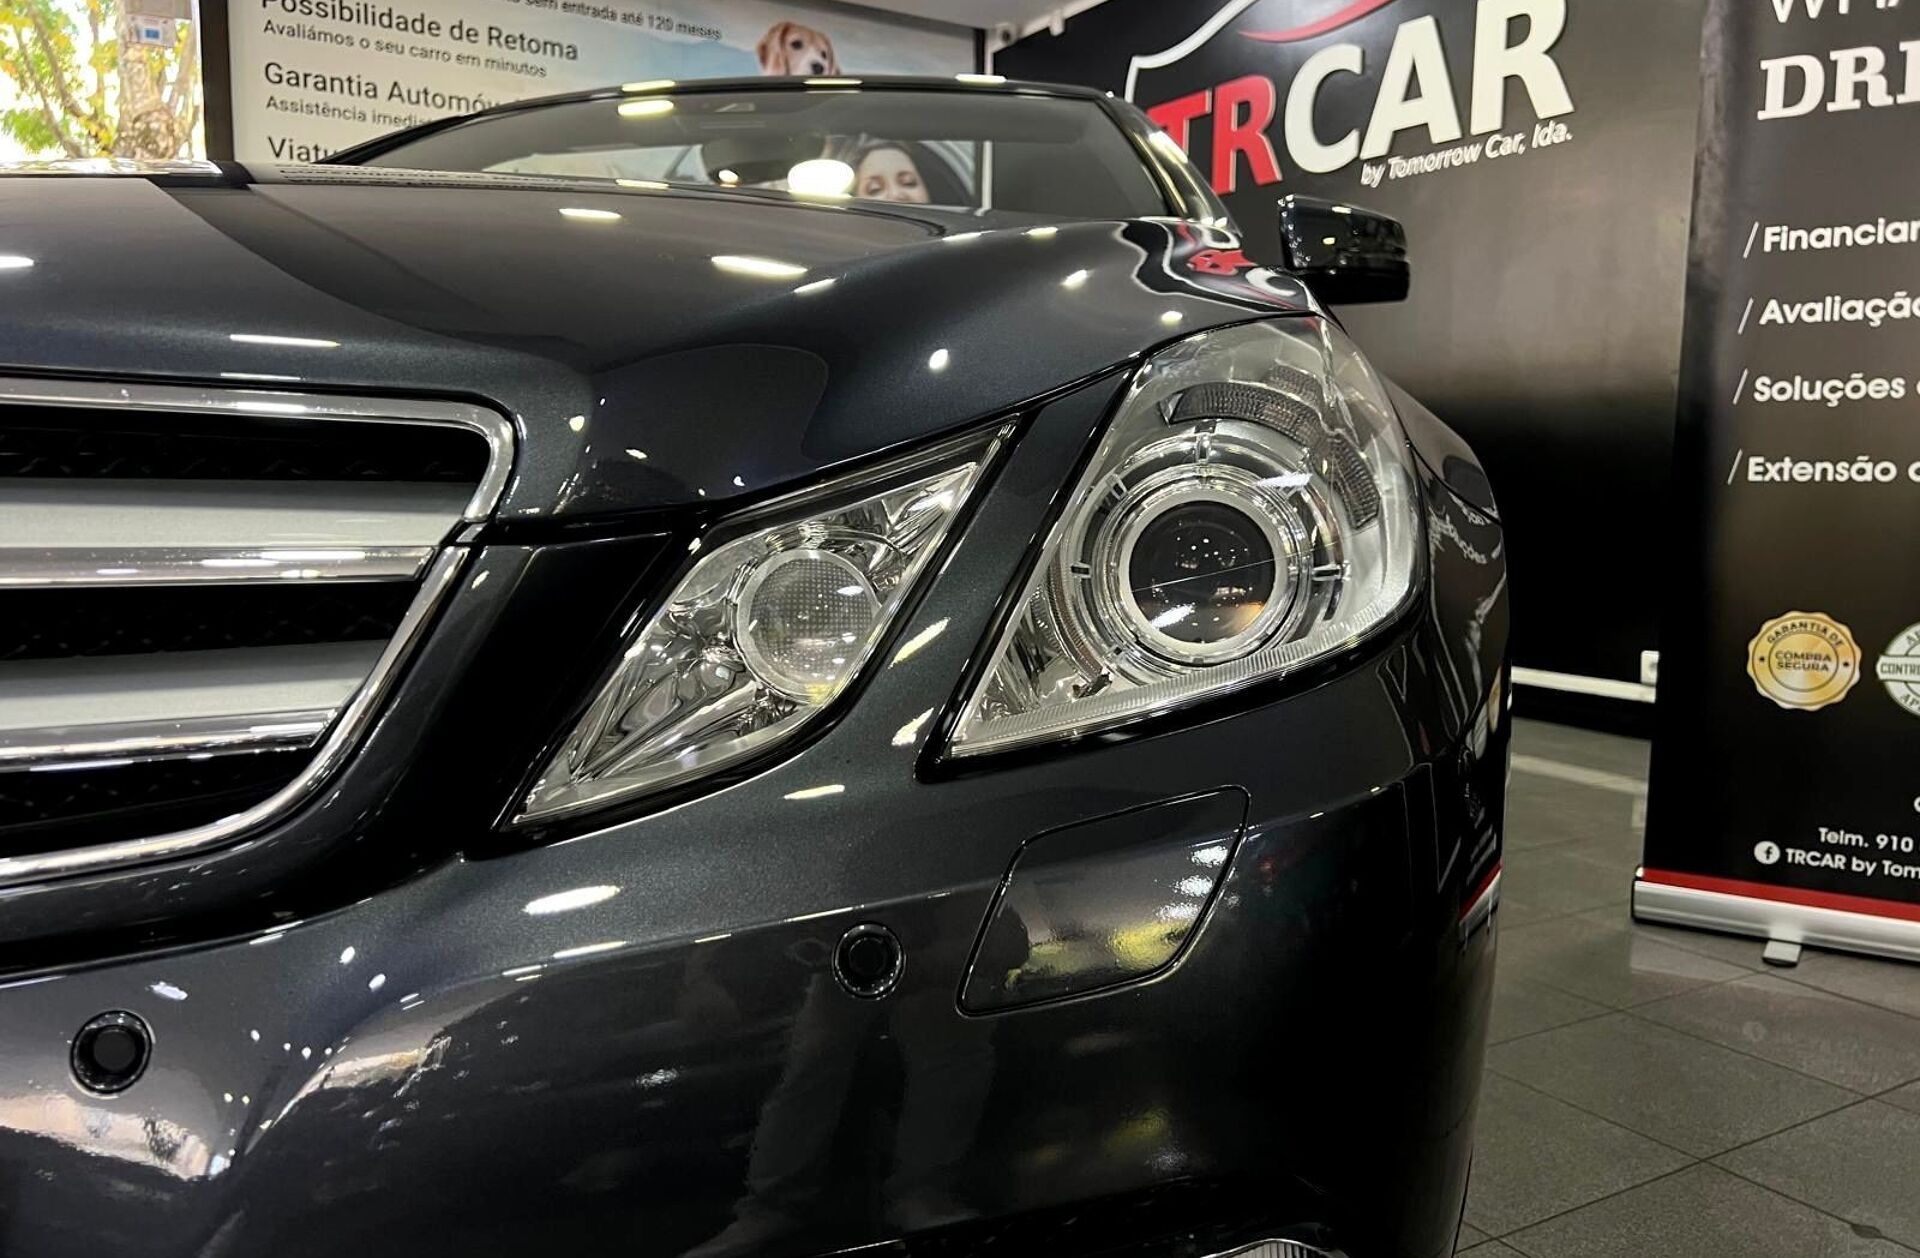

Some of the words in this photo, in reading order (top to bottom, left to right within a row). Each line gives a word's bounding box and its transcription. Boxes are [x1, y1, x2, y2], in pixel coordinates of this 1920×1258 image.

[450, 19, 479, 44] de
[487, 25, 579, 61] Retoma
[647, 14, 674, 32] 120
[675, 22, 722, 41] meses
[263, 19, 354, 47] Avaliámos
[359, 38, 370, 49] o
[374, 39, 405, 55] seu
[409, 45, 451, 63] carro
[455, 53, 481, 68] em
[484, 57, 547, 78] minutos
[264, 62, 379, 99] Garantia
[265, 95, 367, 123] Assistência
[1360, 163, 1386, 188] by
[1388, 142, 1483, 180] Tomorrow
[1485, 132, 1526, 159] Car,
[1753, 372, 1906, 407] Soluções
[1747, 455, 1897, 482] Extensão
[1767, 622, 1828, 644] GARANTIA
[1775, 650, 1832, 662] COMPRA
[1777, 661, 1829, 672] SEGURA
[1818, 826, 1869, 848] Telm.
[1876, 833, 1914, 853] 910
[1786, 848, 1847, 870] TRCAR
[1851, 856, 1877, 877] by
